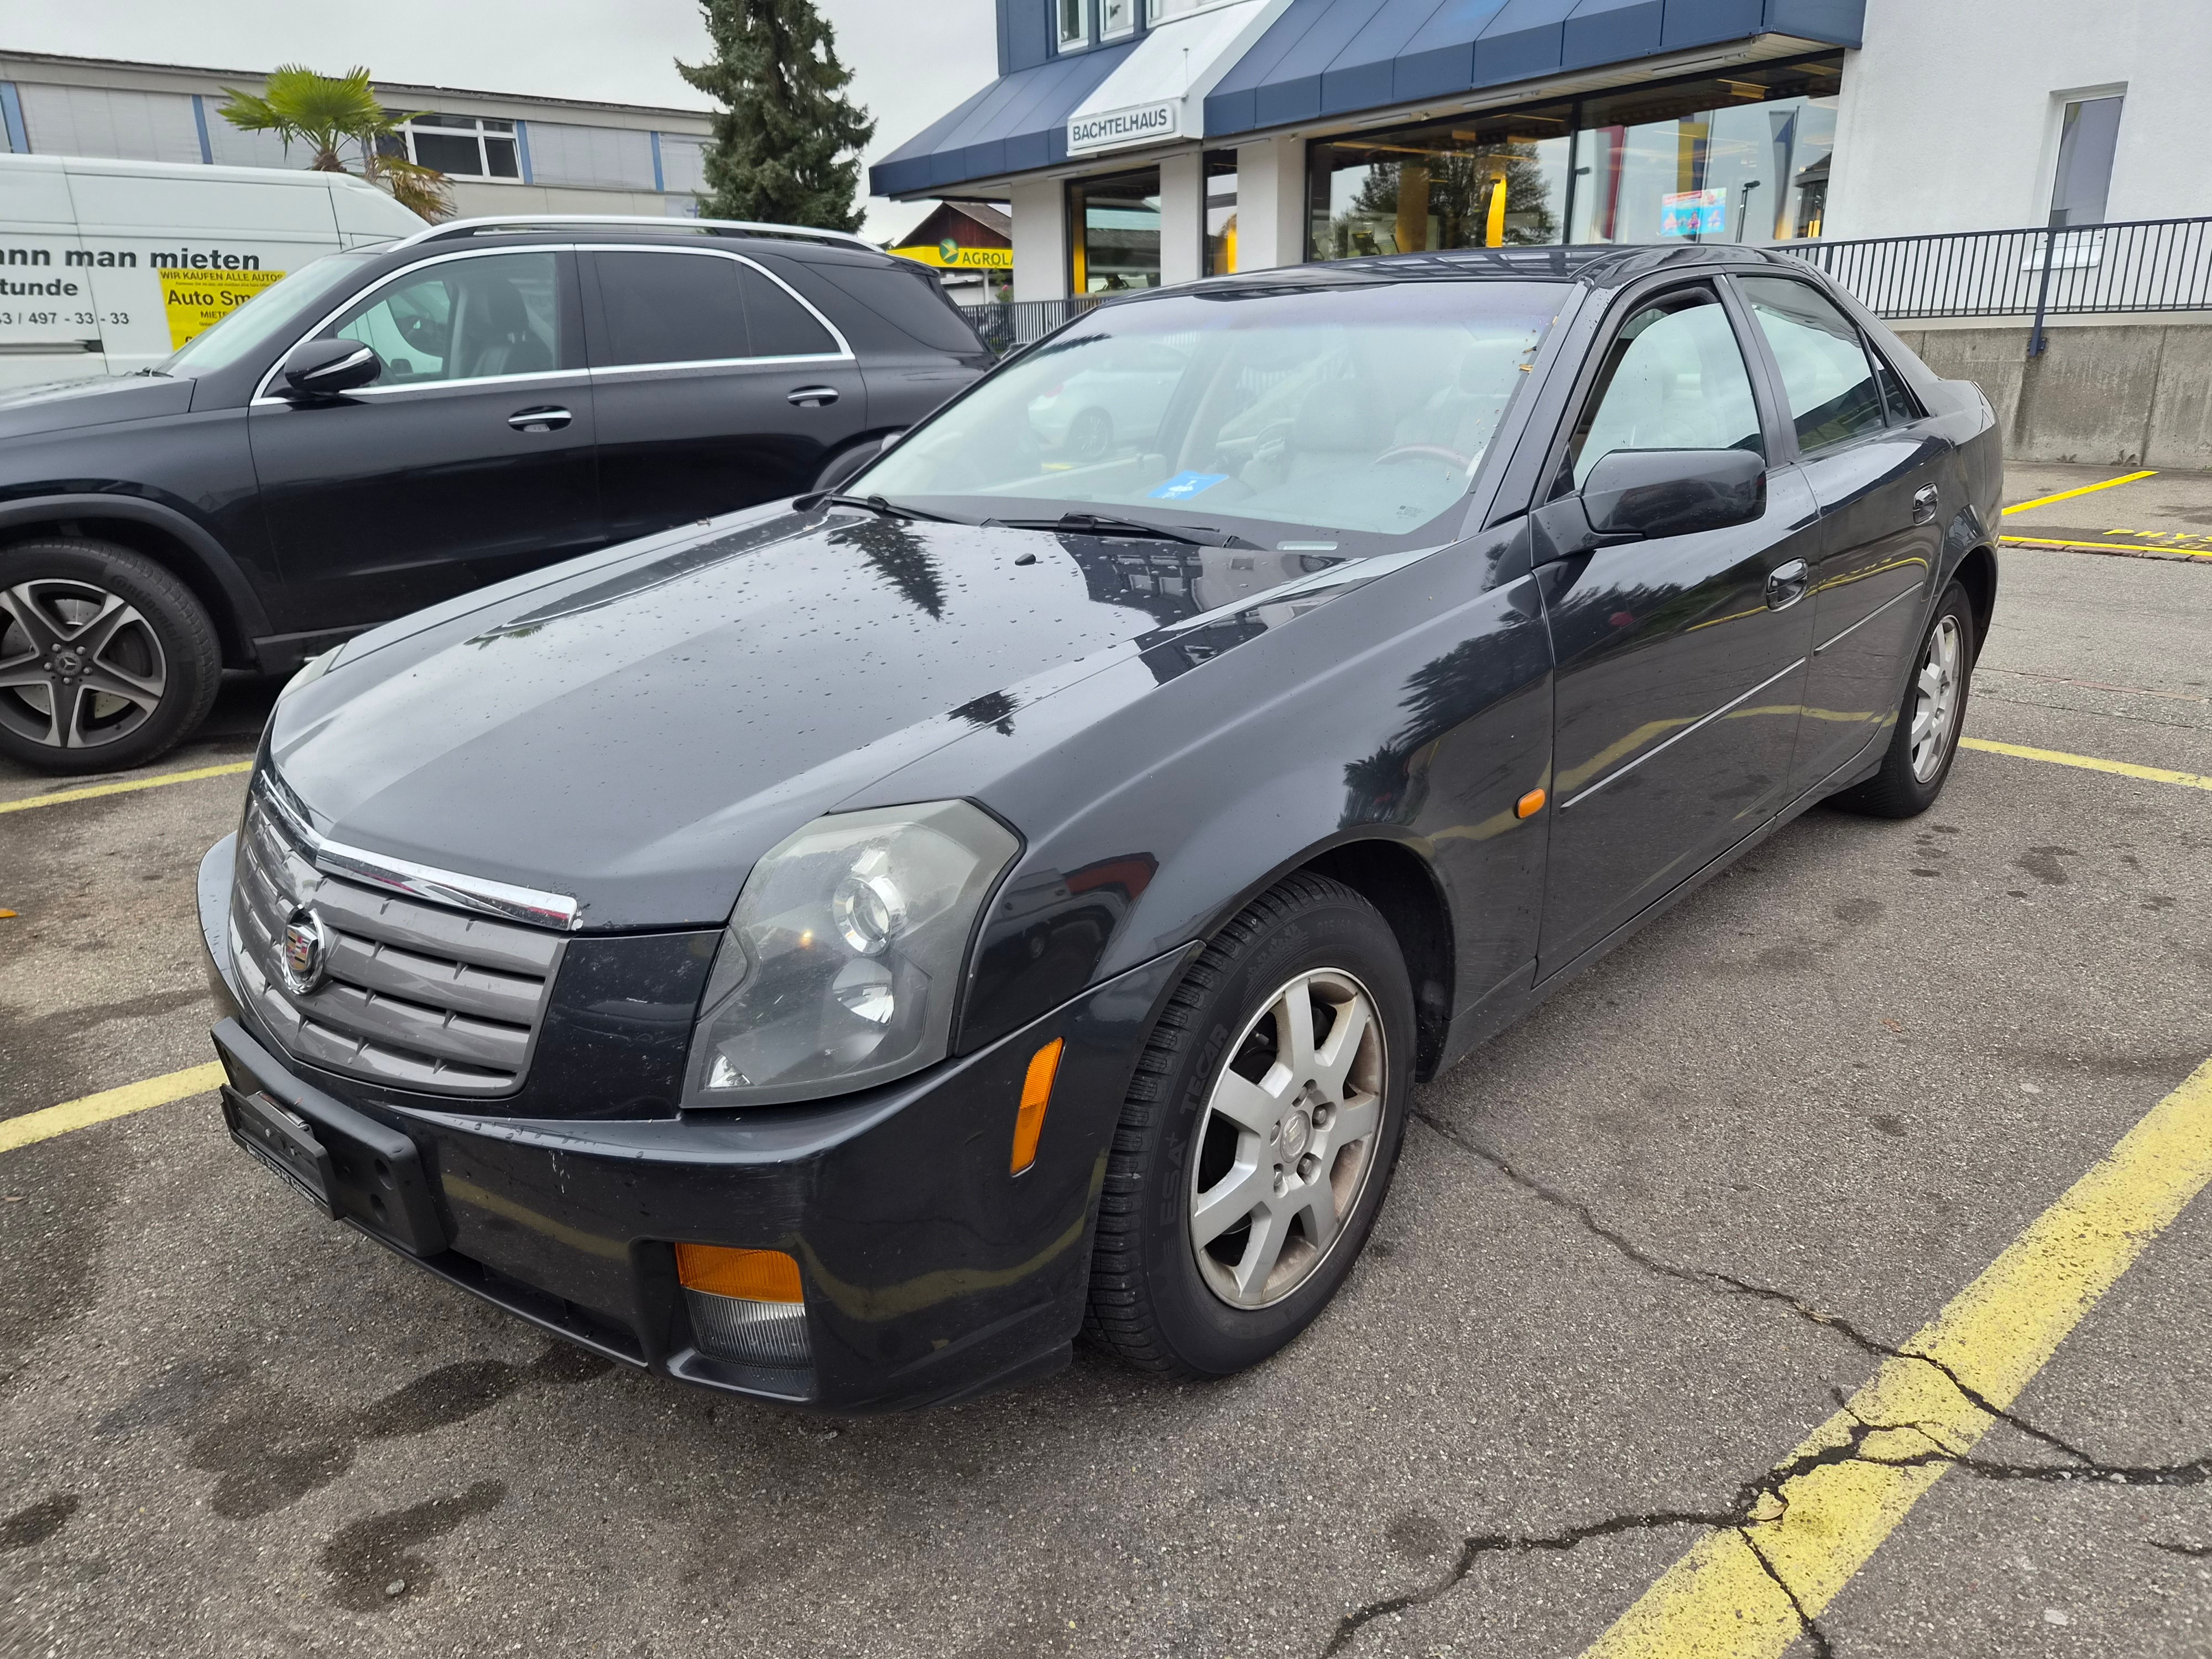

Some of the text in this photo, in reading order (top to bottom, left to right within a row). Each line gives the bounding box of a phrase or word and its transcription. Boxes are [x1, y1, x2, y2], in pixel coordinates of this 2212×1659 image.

[1073, 109, 1167, 141] BACHTELHAUS
[65, 250, 137, 268] man
[150, 247, 260, 270] mieten
[160, 271, 181, 280] WIR
[183, 272, 223, 281] KAUFEN
[226, 273, 249, 281] ALLE
[0, 279, 78, 296] tunde
[167, 289, 214, 306] Auto
[0, 312, 12, 325] 3
[28, 312, 57, 325] 497
[74, 312, 95, 325] 33
[110, 312, 129, 325] 33
[1180, 1022, 1229, 1115] TECAR
